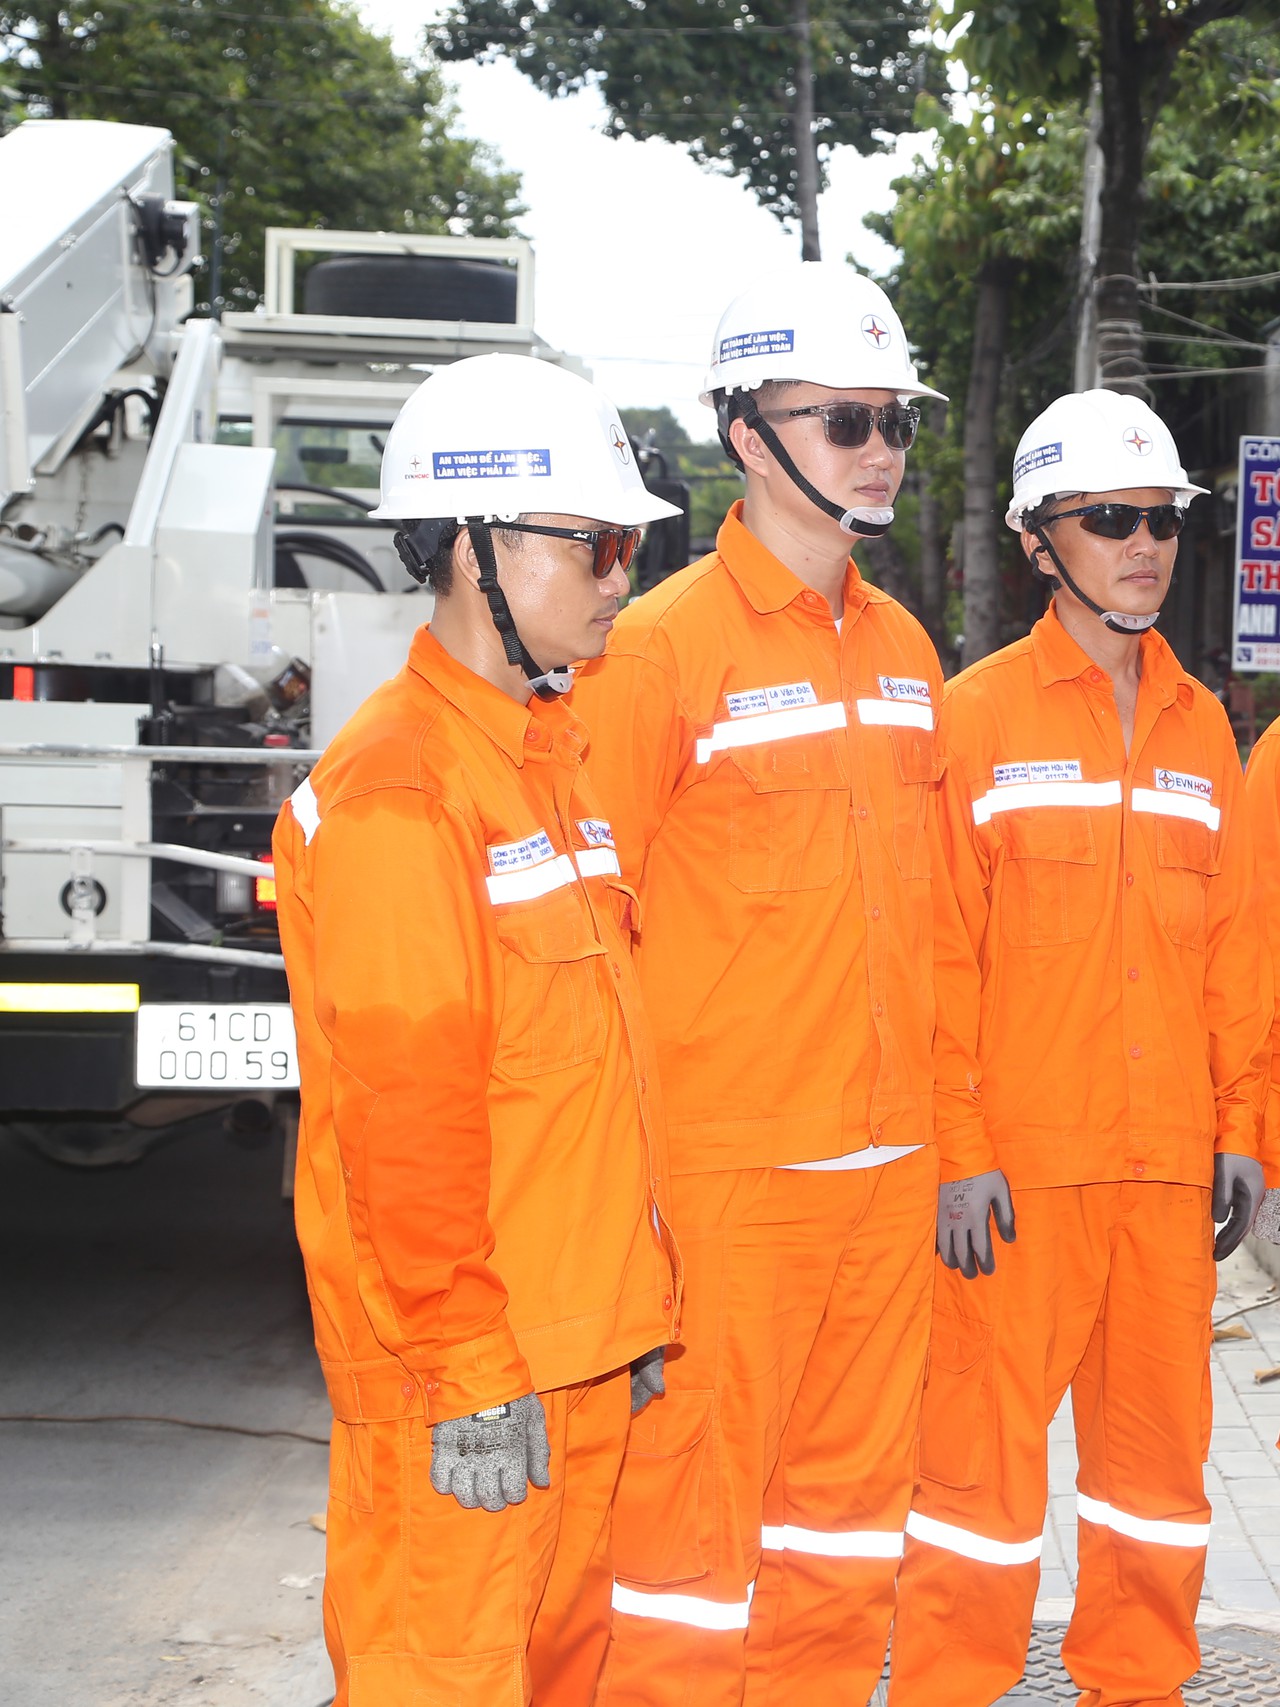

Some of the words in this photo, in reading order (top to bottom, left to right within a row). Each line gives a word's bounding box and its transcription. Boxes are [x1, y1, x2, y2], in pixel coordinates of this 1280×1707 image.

[753, 333, 768, 344] LÀM
[769, 332, 788, 342] VIỆC,
[743, 344, 758, 356] PHẢI
[759, 345, 770, 353] AN
[771, 342, 791, 352] TOÀN
[439, 455, 452, 465] AN
[453, 453, 478, 465] TOÀN
[479, 452, 492, 464] ĐỂ
[494, 452, 515, 463] LÀM
[436, 467, 456, 477] LÀM
[457, 465, 478, 478] VIỆC
[480, 464, 503, 476] PHẢI
[1237, 604, 1276, 637] ANH
[780, 689, 795, 697] Văn
[796, 685, 810, 695] Đức
[898, 684, 916, 696] EVN
[1176, 777, 1193, 790] EVN
[493, 849, 508, 859] CÔNG
[179, 1012, 271, 1041] 61CD
